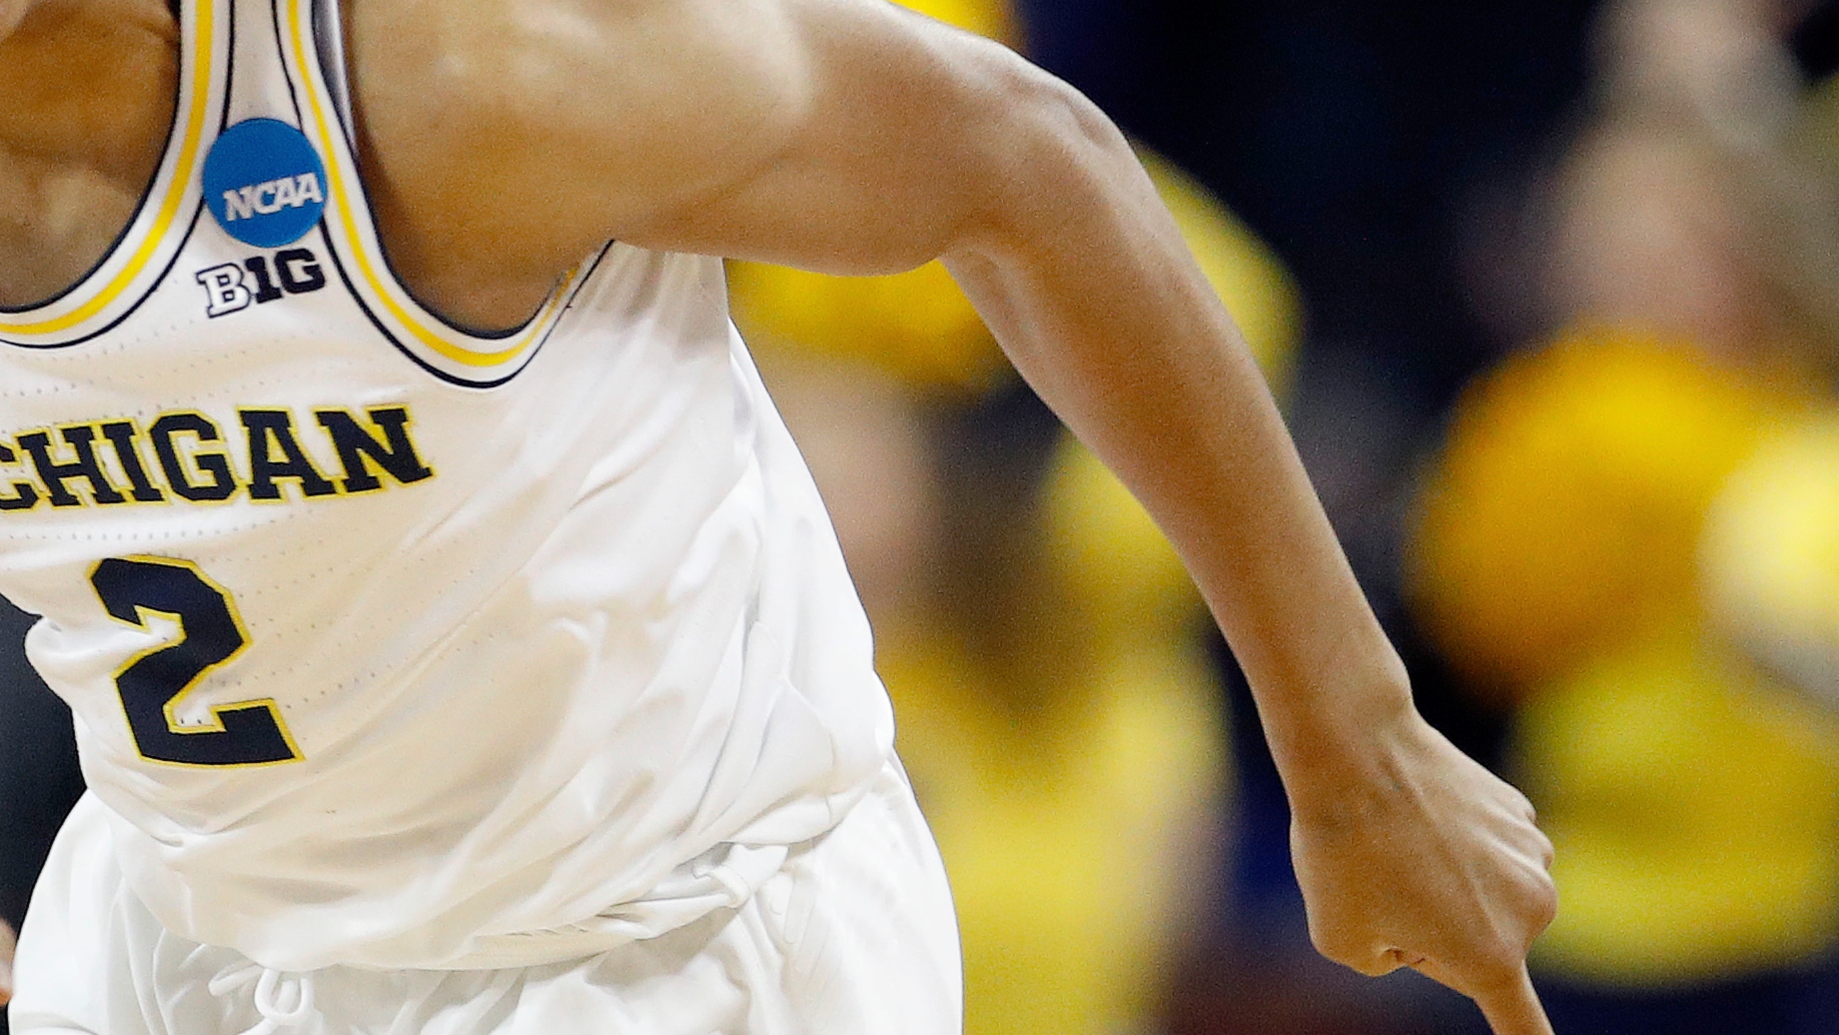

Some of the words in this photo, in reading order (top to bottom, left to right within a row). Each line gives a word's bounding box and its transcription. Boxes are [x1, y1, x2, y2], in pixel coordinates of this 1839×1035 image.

[223, 172, 324, 222] NCAA
[195, 248, 326, 319] BIG
[86, 554, 306, 768] 2
